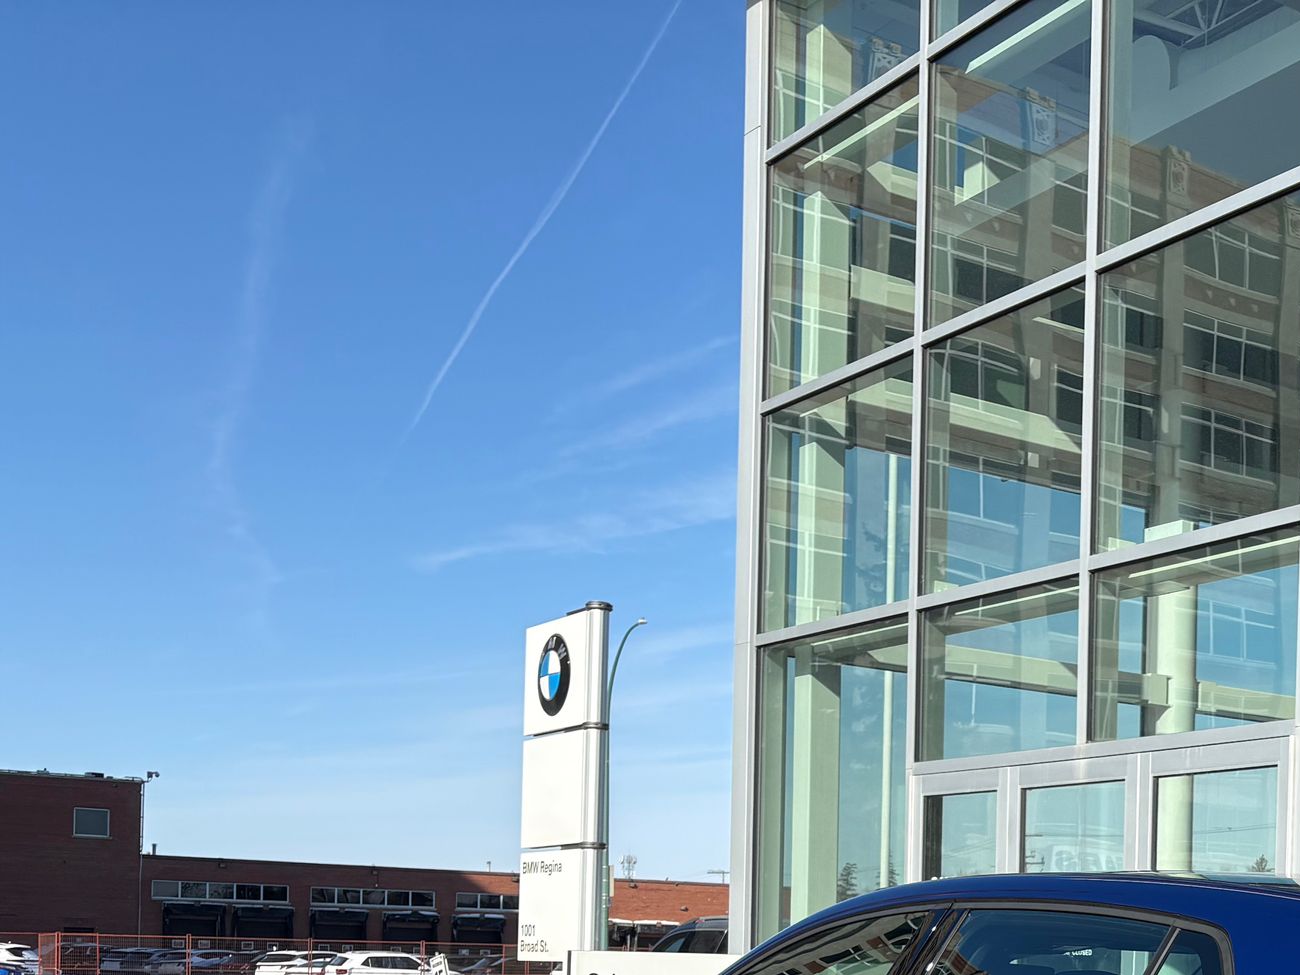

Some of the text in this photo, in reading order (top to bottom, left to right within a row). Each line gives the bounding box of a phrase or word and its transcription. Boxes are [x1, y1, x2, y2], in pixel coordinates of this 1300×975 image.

[522, 859, 562, 876] BMW Regina
[521, 924, 536, 937] 1001
[520, 939, 549, 952] Broad St.
